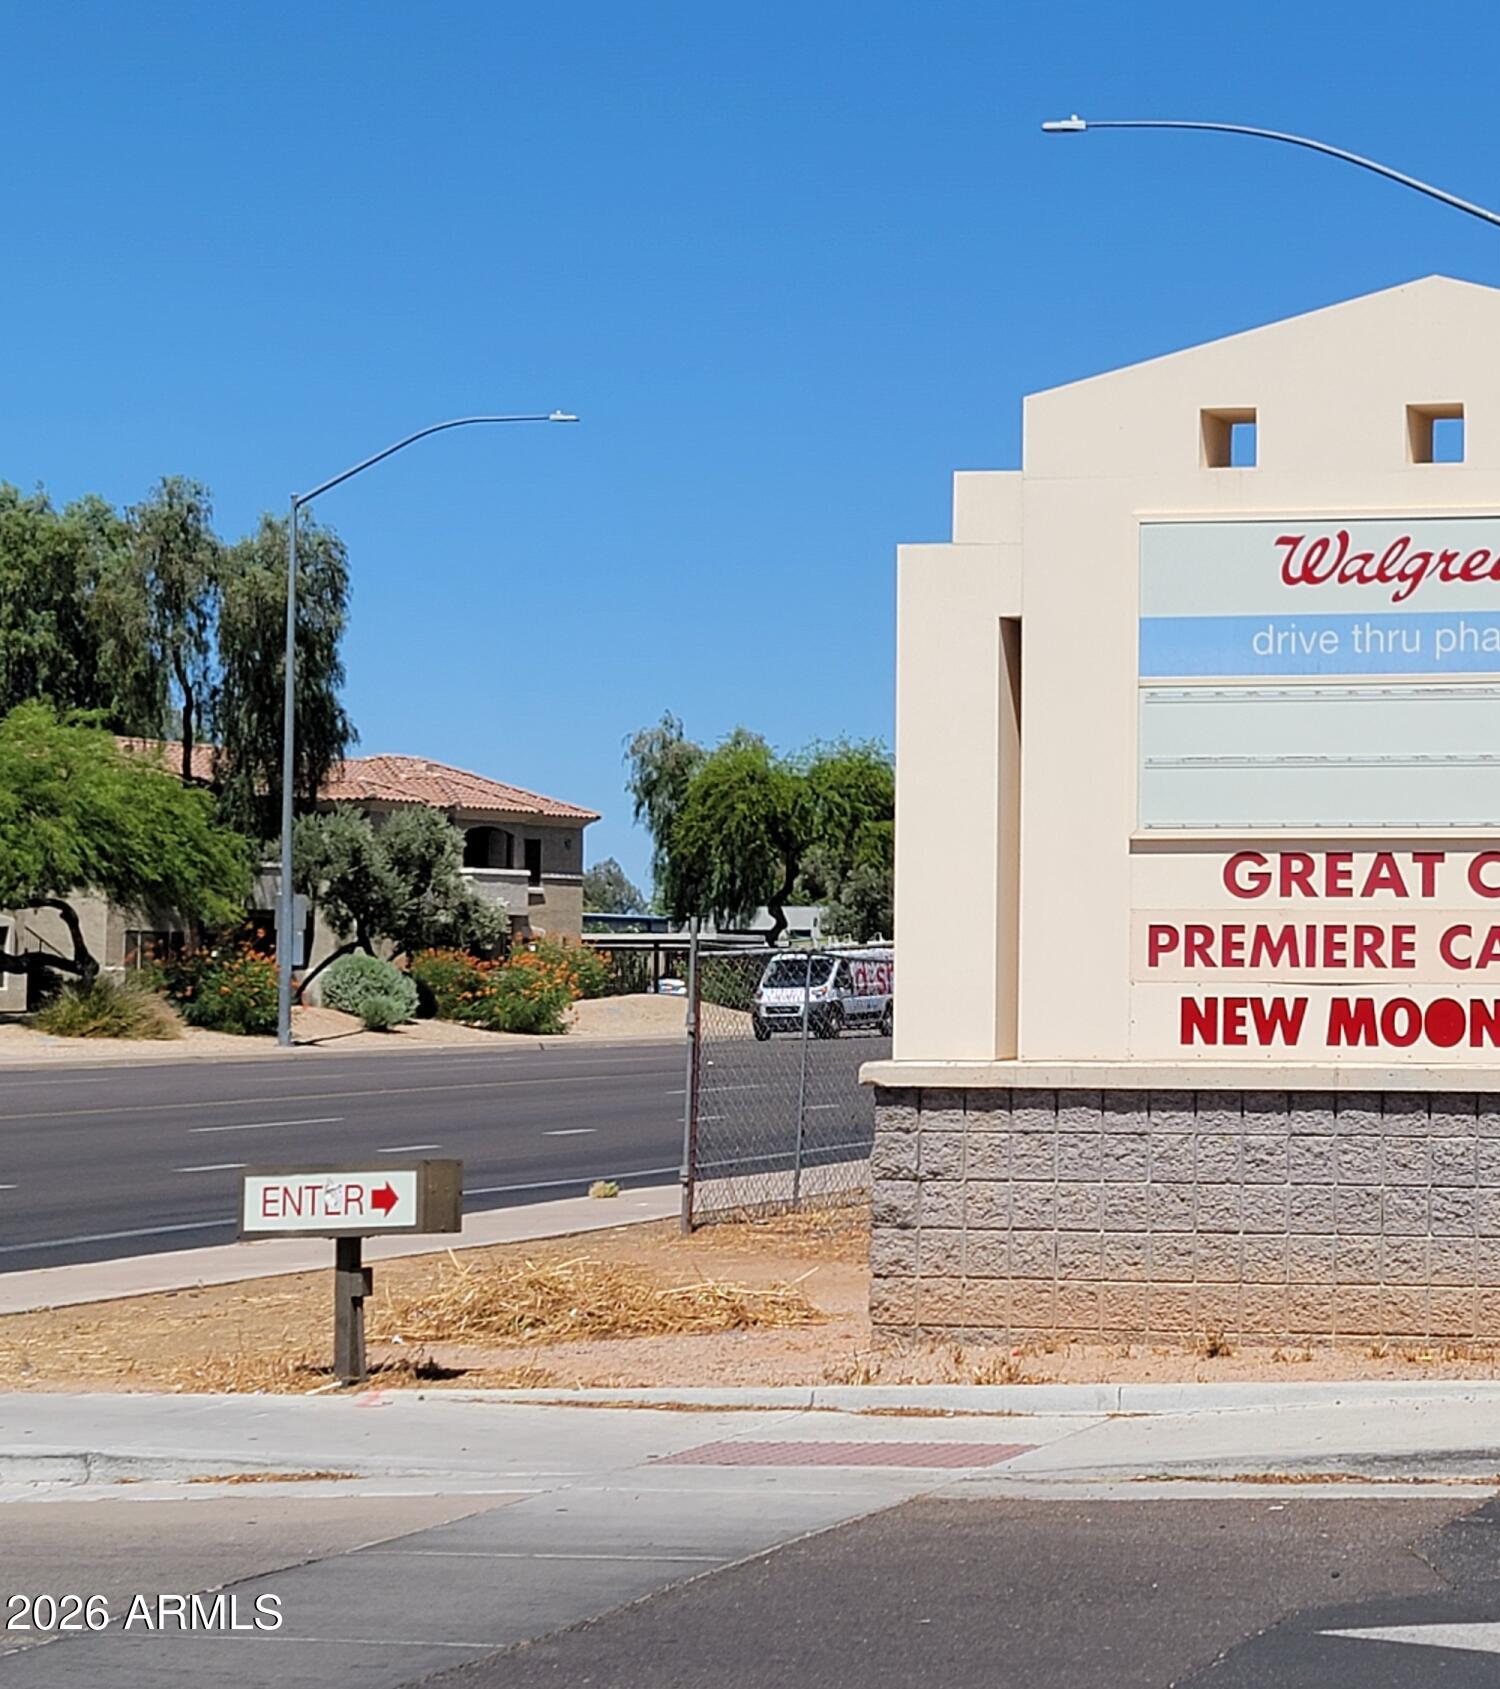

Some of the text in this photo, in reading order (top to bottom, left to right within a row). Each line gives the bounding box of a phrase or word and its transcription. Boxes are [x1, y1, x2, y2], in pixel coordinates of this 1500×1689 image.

[1253, 624, 1339, 656] drive
[1351, 622, 1421, 653] thru
[1222, 851, 1445, 900] GREAT
[1147, 923, 1417, 970] PREMIERE
[1179, 996, 1308, 1047] NEW
